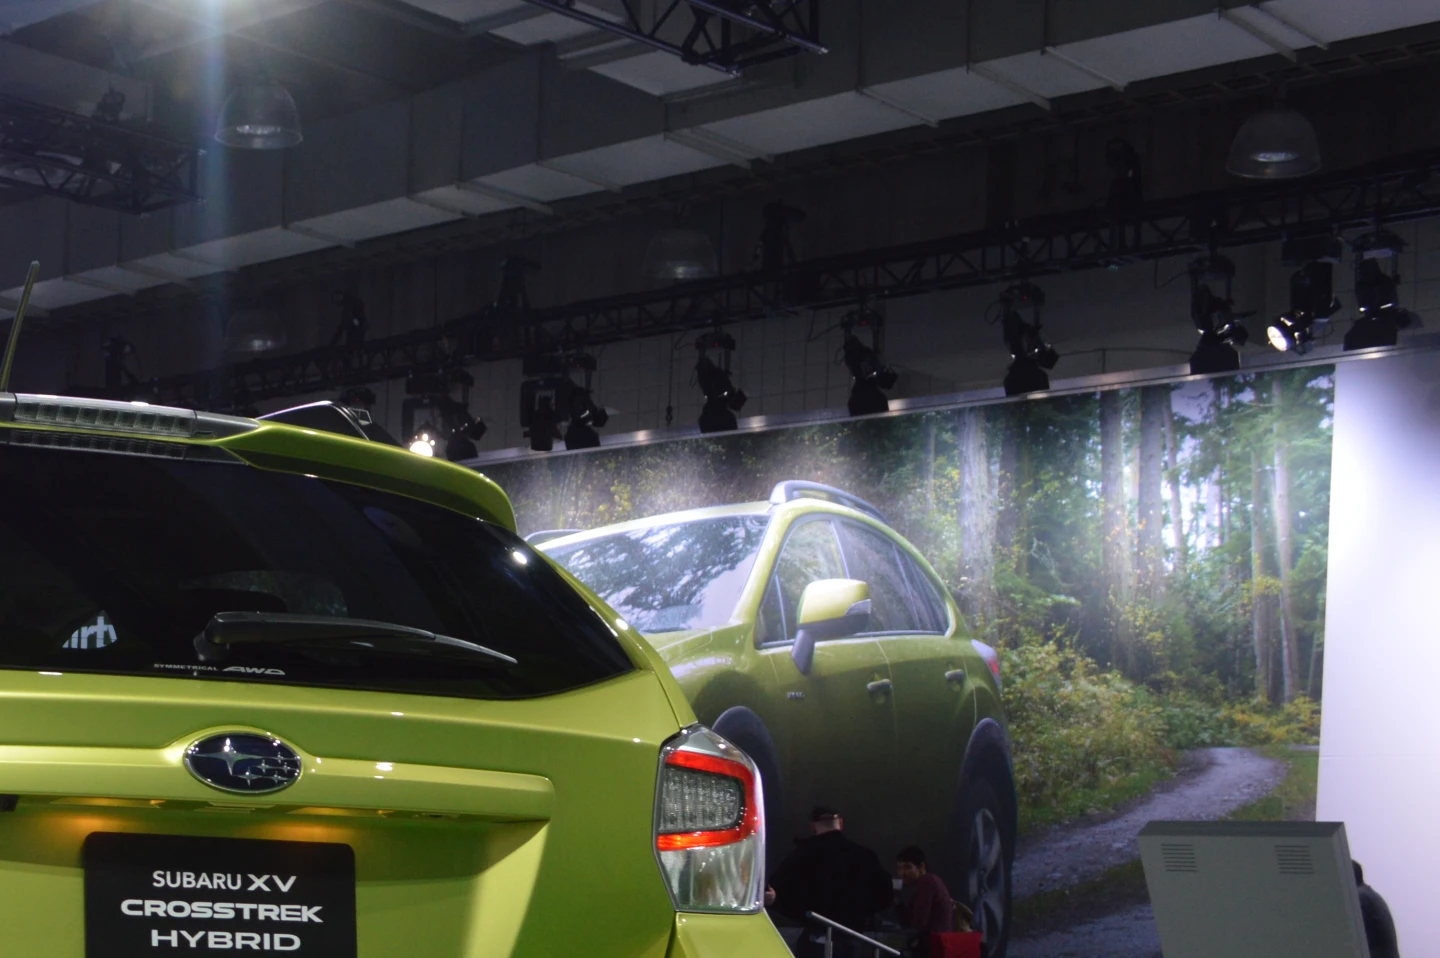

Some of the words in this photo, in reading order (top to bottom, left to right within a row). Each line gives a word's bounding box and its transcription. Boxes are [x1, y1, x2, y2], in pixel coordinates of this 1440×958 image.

[153, 663, 219, 671] SYMMETRICAL
[222, 665, 286, 676] AWD
[152, 870, 242, 890] SUBARU
[247, 873, 297, 893] XV
[120, 898, 324, 923] CROSSTREK
[151, 929, 301, 951] HYBRID
